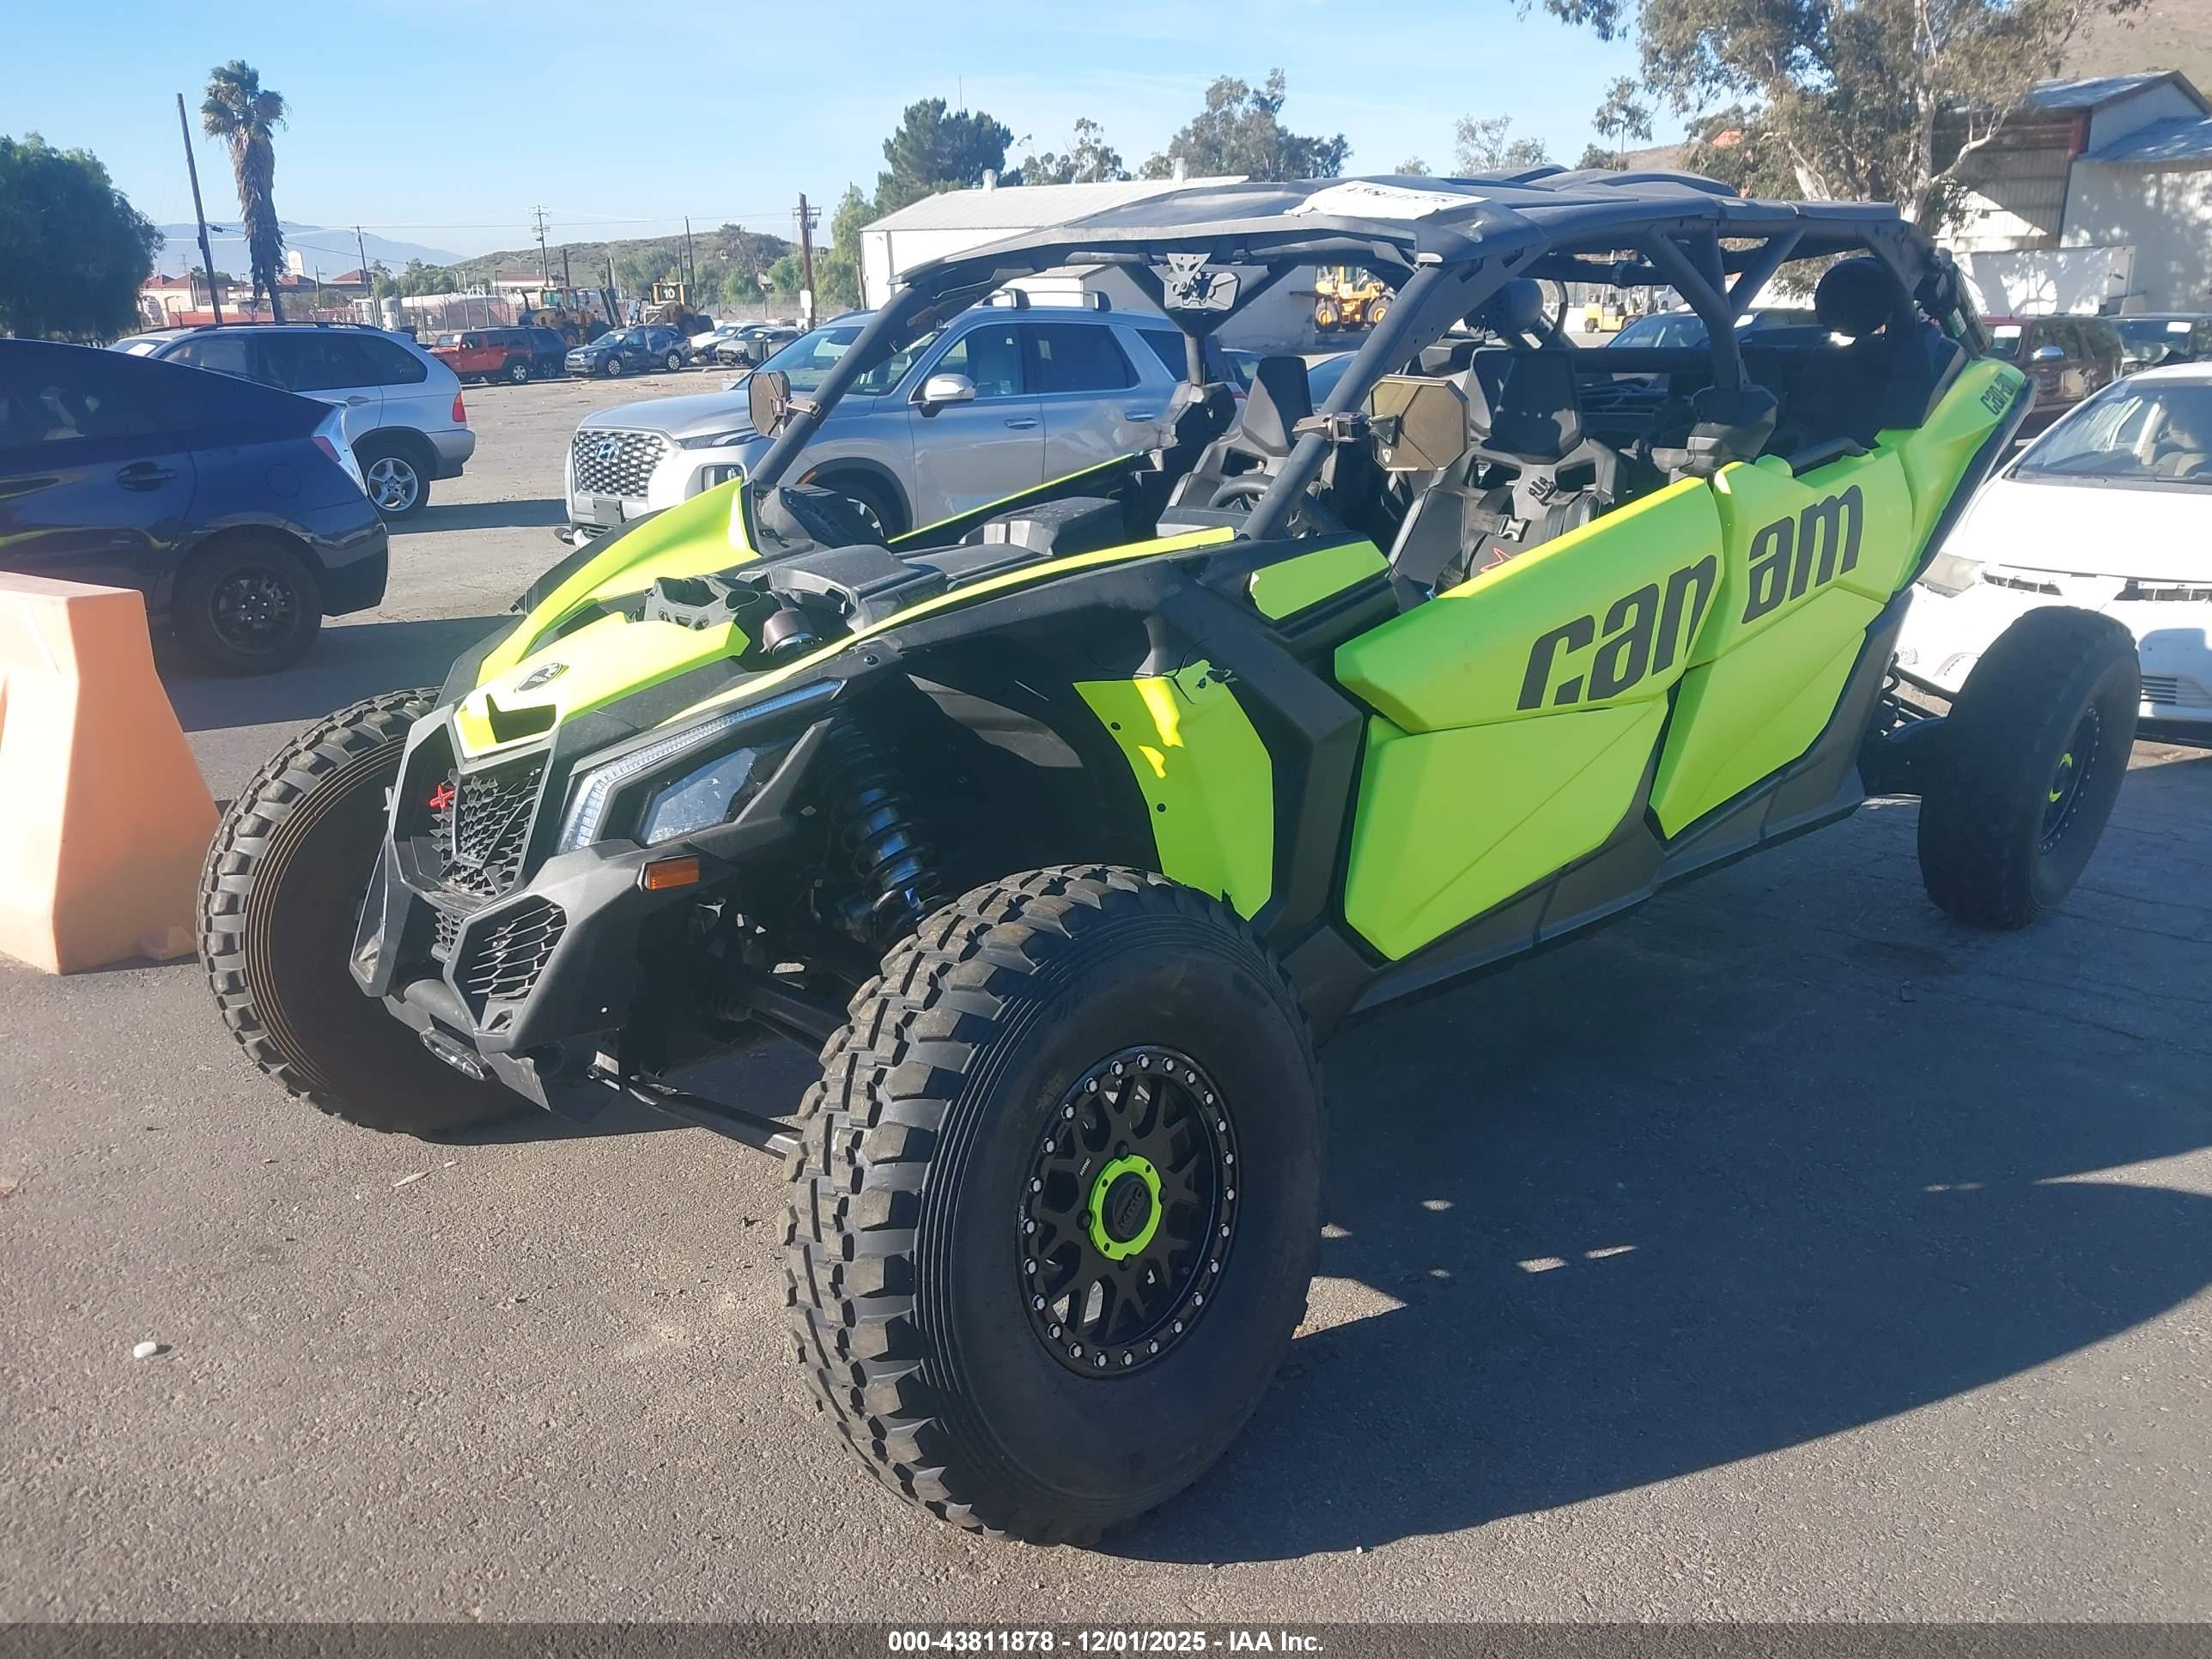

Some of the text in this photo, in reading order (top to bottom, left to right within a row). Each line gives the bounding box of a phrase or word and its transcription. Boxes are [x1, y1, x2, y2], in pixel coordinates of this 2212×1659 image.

[662, 287, 676, 299] 10
[1516, 483, 1864, 711] can am
